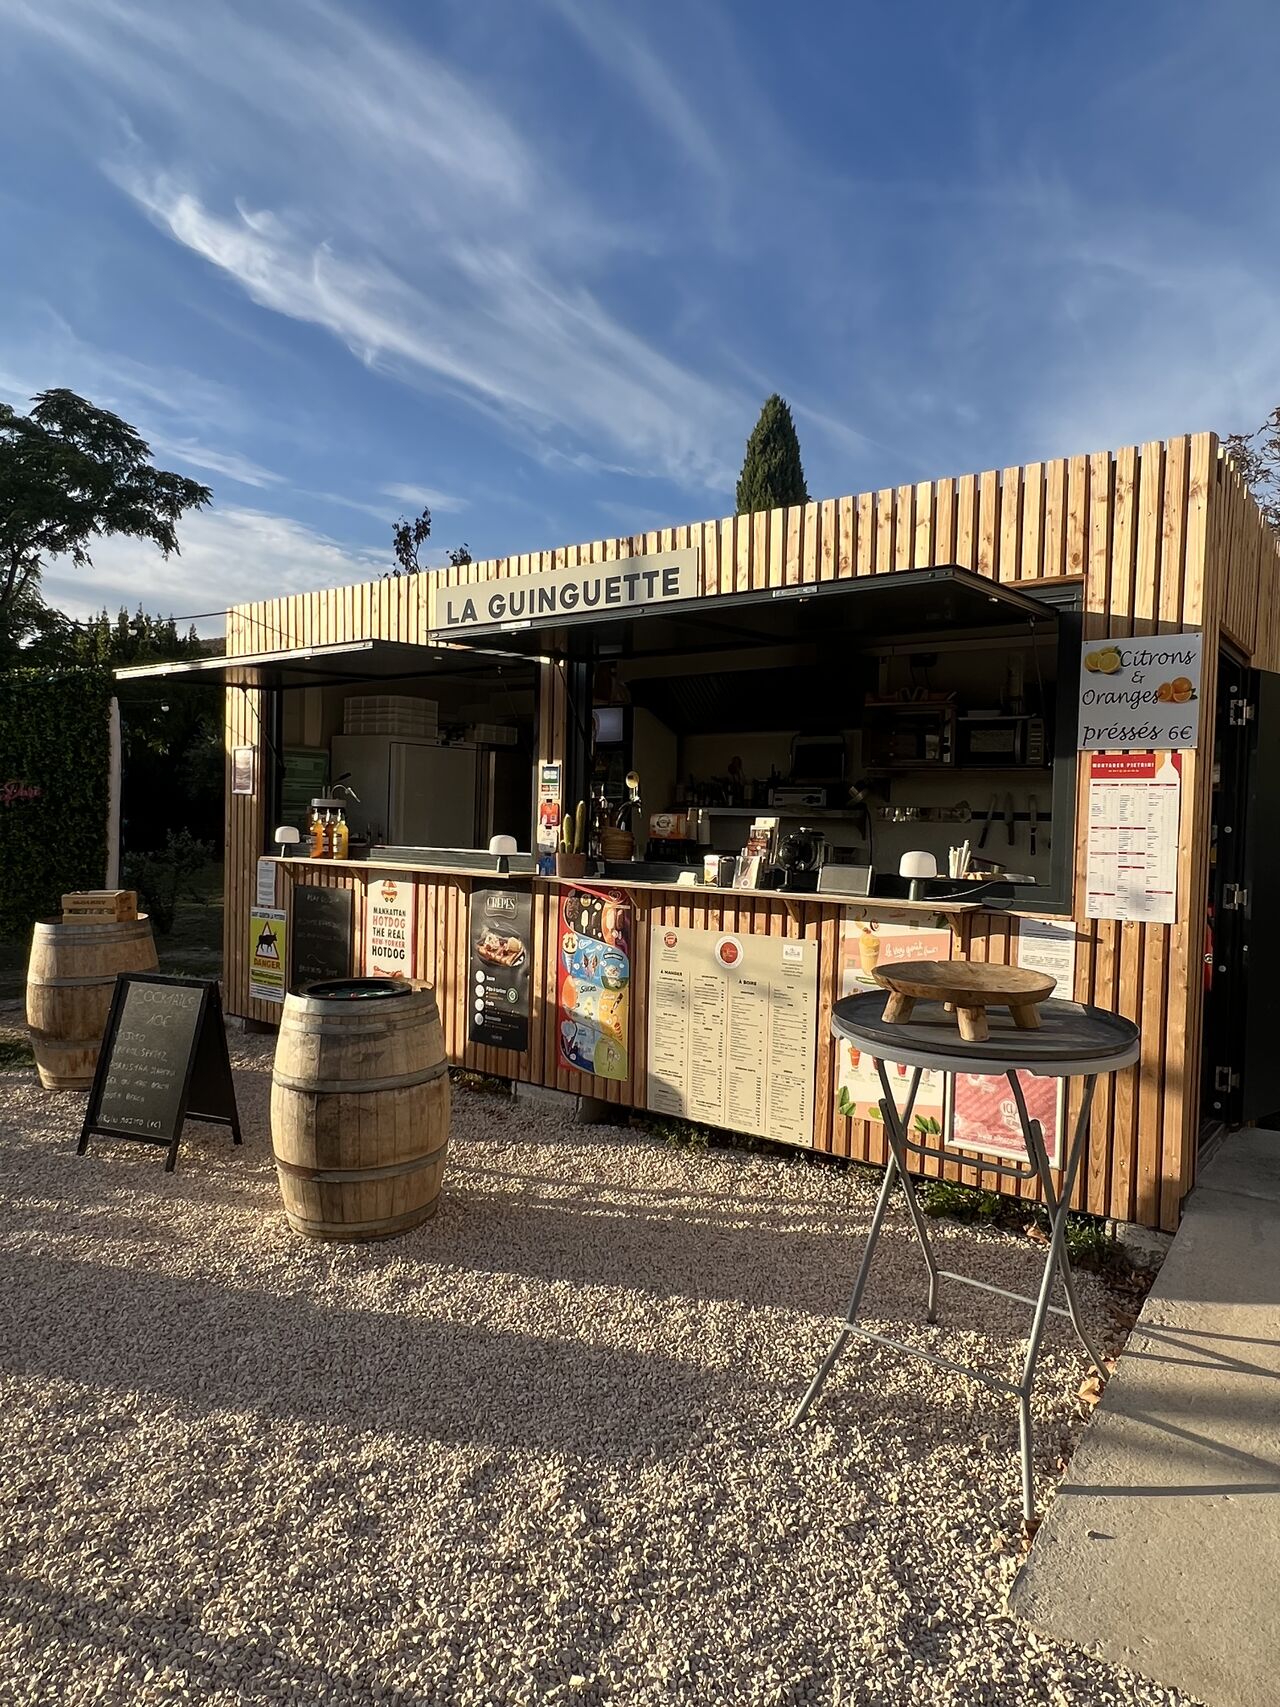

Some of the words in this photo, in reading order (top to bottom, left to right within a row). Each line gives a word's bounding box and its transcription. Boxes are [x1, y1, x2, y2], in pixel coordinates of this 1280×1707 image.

[447, 598, 478, 624] LA
[487, 567, 680, 617] GUINGUETTE
[1120, 650, 1196, 668] Citrons
[1131, 670, 1146, 684] &
[1082, 689, 1160, 709] Oranges
[1083, 722, 1164, 746] préssés
[1168, 726, 1192, 741] 6€
[373, 907, 406, 918] MANHATTAN
[372, 916, 406, 929] HOTDOG
[373, 927, 386, 938] THE
[387, 929, 405, 940] REAL
[372, 938, 383, 946] NEW
[384, 939, 406, 949] YORKER
[372, 946, 406, 960] HOTDOG
[254, 957, 281, 969] DANGER
[132, 989, 196, 1011] COCKTAILS
[146, 1013, 172, 1026] 10€
